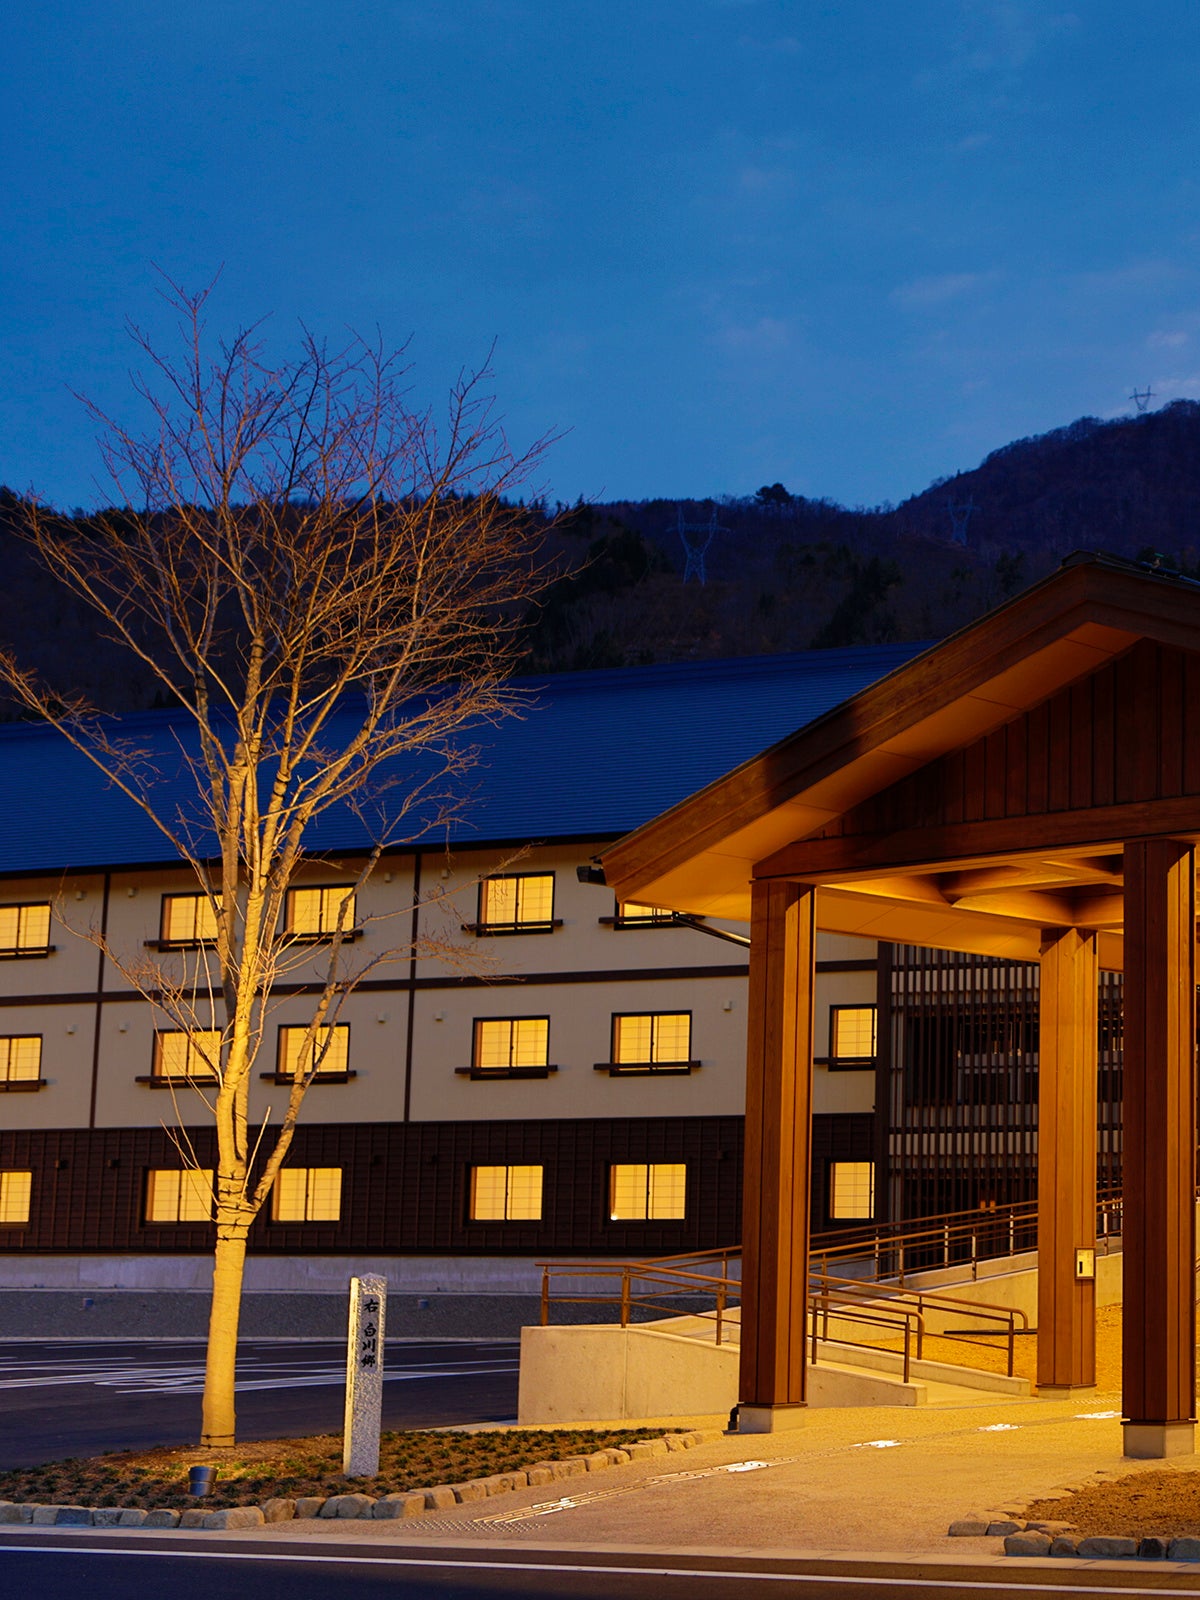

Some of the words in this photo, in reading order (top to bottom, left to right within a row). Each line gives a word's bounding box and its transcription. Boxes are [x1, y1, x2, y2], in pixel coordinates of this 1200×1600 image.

[363, 1299, 379, 1313] 右
[361, 1323, 377, 1368] 白川郷
